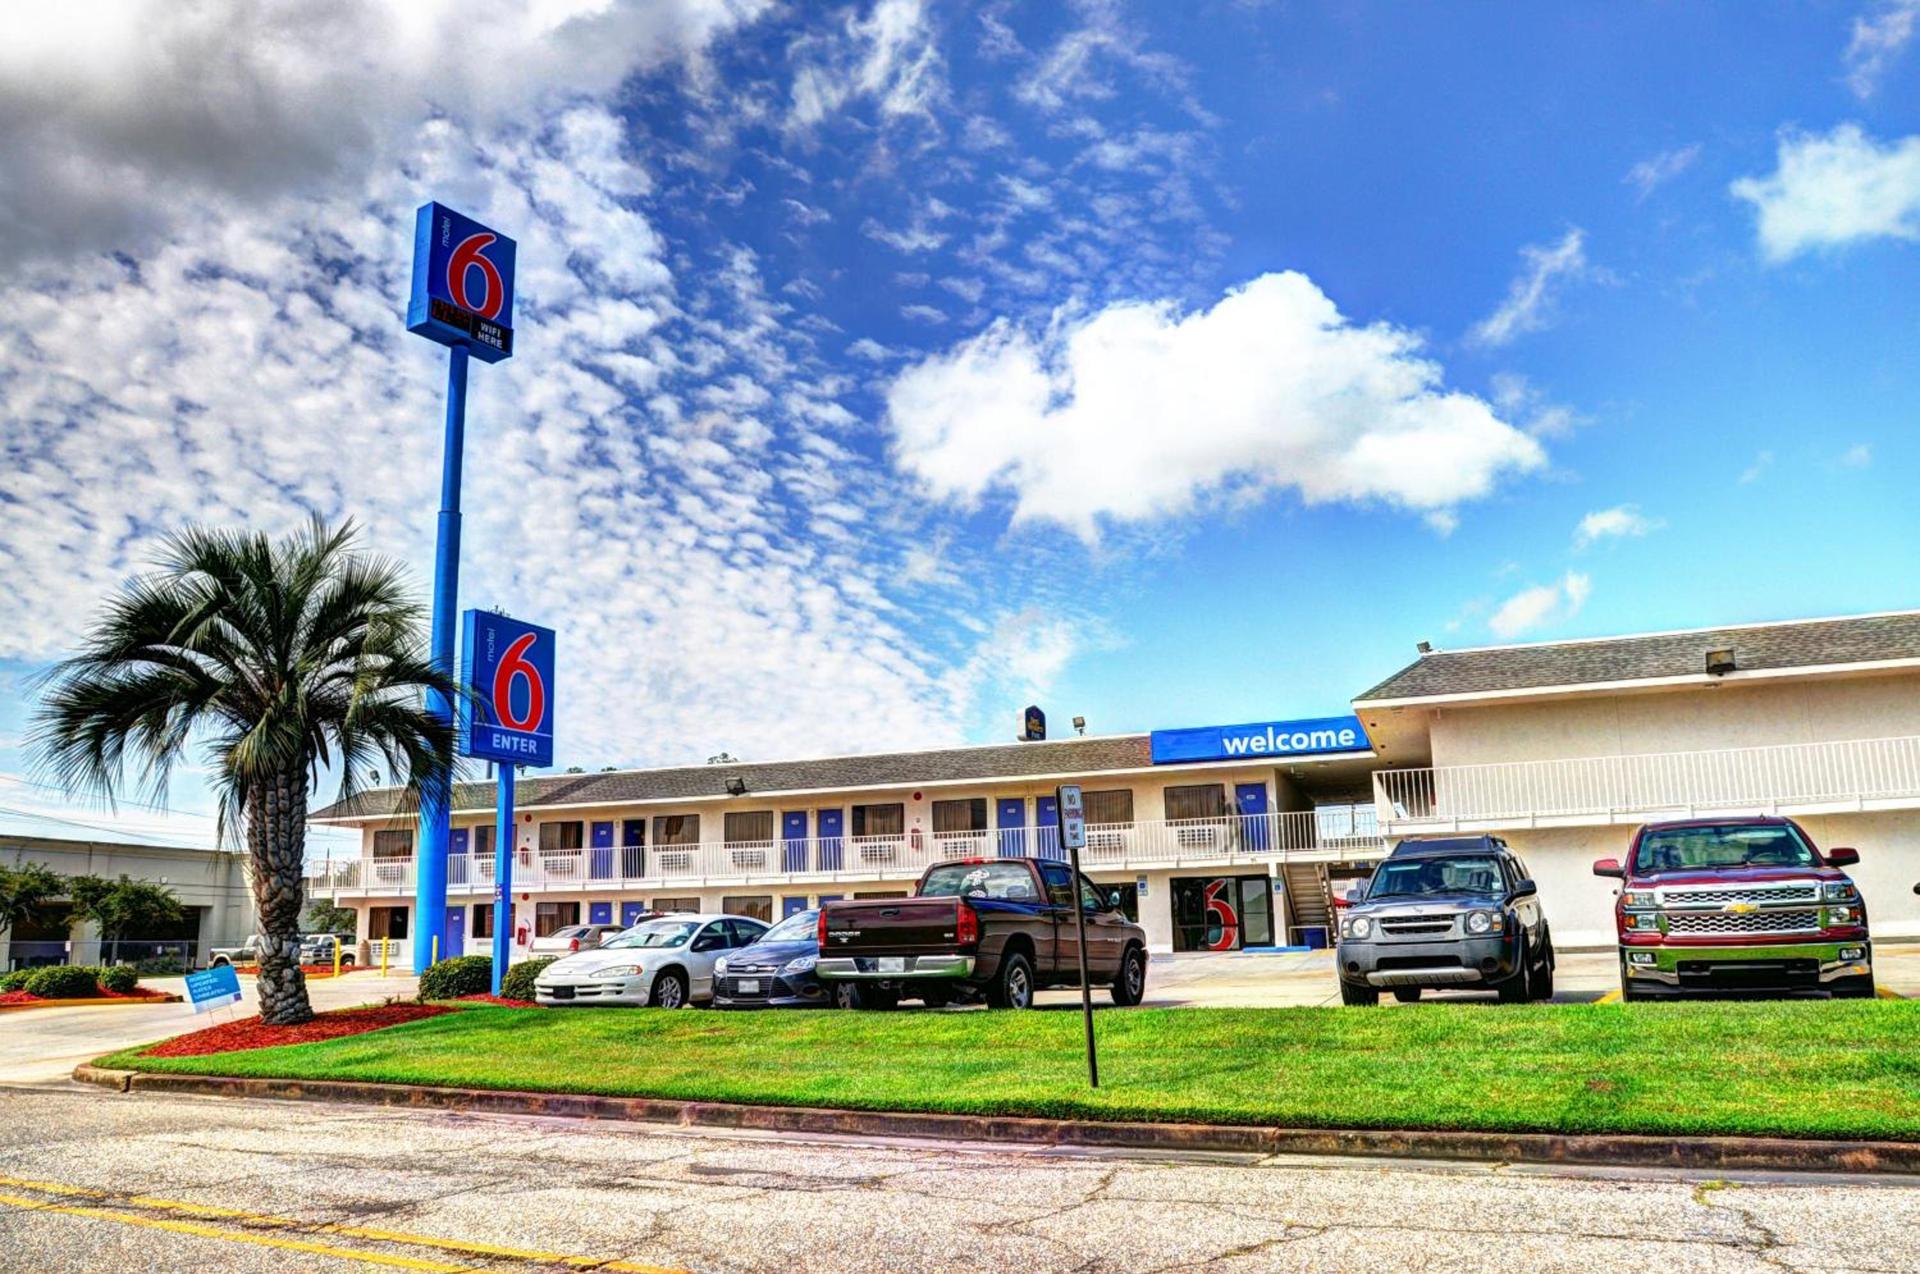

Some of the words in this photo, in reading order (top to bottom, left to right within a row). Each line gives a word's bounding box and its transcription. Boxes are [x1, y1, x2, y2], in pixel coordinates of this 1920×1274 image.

[446, 232, 505, 321] 6
[477, 331, 503, 349] HERE
[480, 322, 502, 337] WIFI
[487, 627, 496, 662] motel
[493, 632, 545, 733] 6
[492, 734, 538, 754] ENTER
[1222, 726, 1356, 755] welcome
